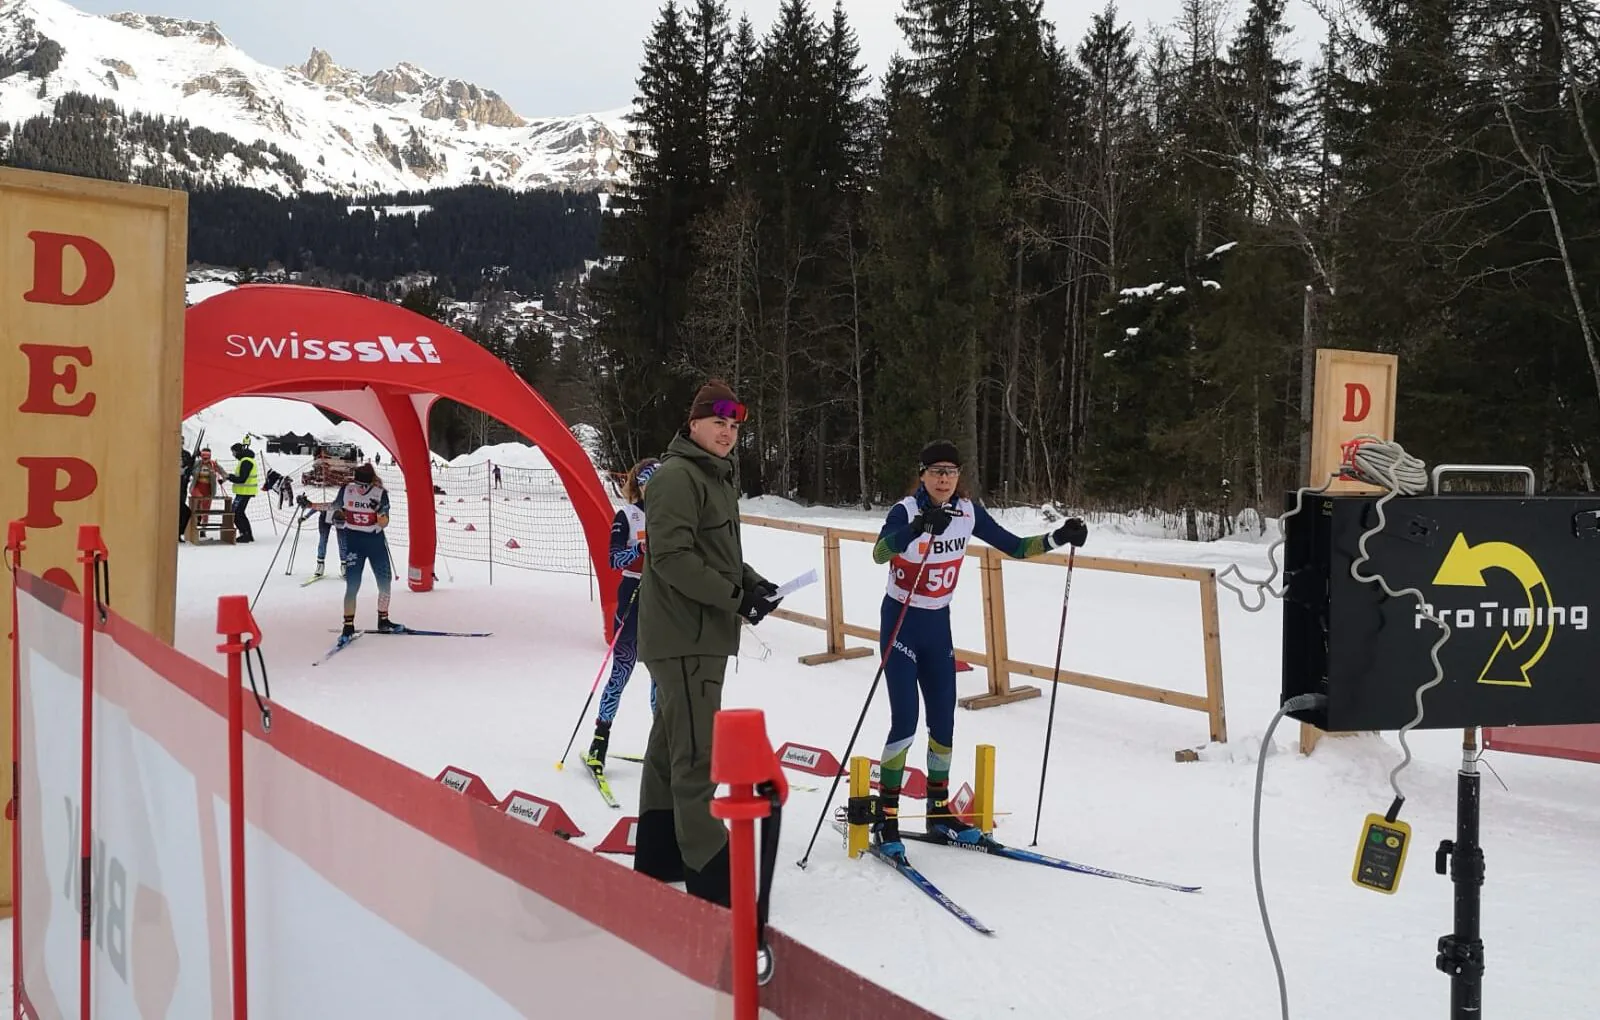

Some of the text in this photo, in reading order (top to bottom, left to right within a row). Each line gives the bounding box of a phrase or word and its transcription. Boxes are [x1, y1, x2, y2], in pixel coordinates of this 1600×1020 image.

[226, 332, 441, 363] swissski
[18, 231, 115, 592] DEP
[353, 514, 369, 523] 53
[933, 537, 965, 554] BKW
[926, 566, 956, 592] 50
[1415, 602, 1588, 630] ProTiming
[511, 803, 534, 819] helvetia
[947, 841, 988, 853] SALOMON
